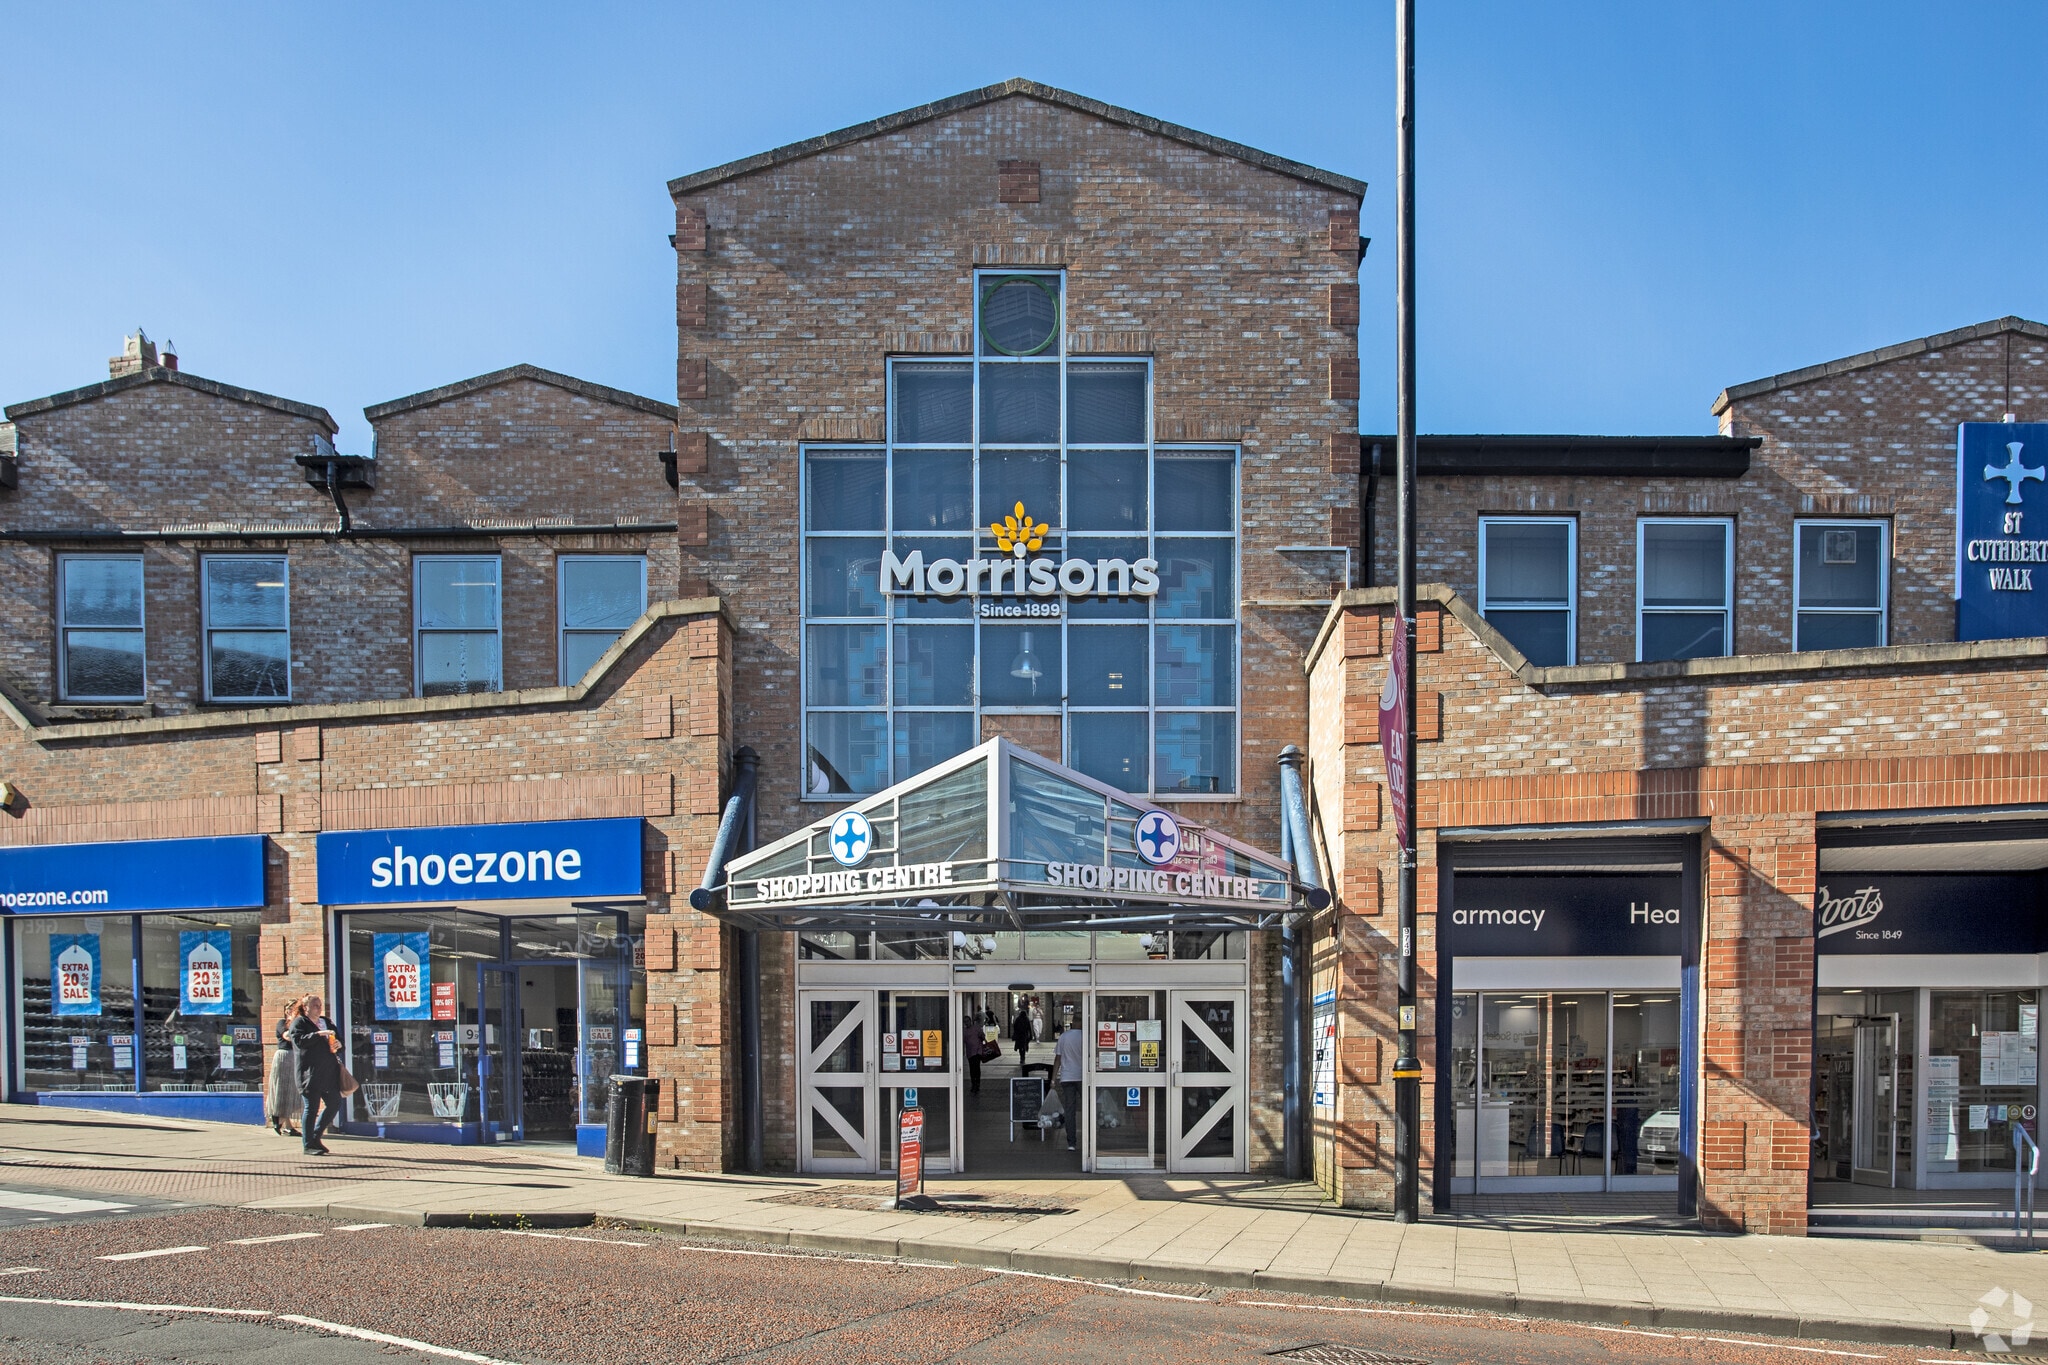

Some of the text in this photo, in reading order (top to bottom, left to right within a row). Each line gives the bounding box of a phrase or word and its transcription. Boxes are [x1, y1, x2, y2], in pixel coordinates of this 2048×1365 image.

[2003, 512, 2023, 534] ST
[1967, 539, 2048, 562] CUTHBERT
[879, 543, 1160, 596] Morrisons
[1988, 568, 2033, 590] WALK
[980, 604, 1060, 617] Since 1899
[1387, 760, 1405, 799] LOC
[371, 846, 581, 888] shoezone
[757, 861, 953, 901] SHOPPING CENTRE
[1047, 861, 1260, 900] SHOPPING CENTRE
[1452, 902, 1681, 931] armacy Hea
[1855, 930, 1903, 940] Since 1849
[192, 961, 219, 970] EXTRA
[387, 964, 417, 973] EXTRA
[64, 988, 89, 999] SALE
[192, 987, 220, 998] SALE
[389, 991, 417, 1002] SALE
